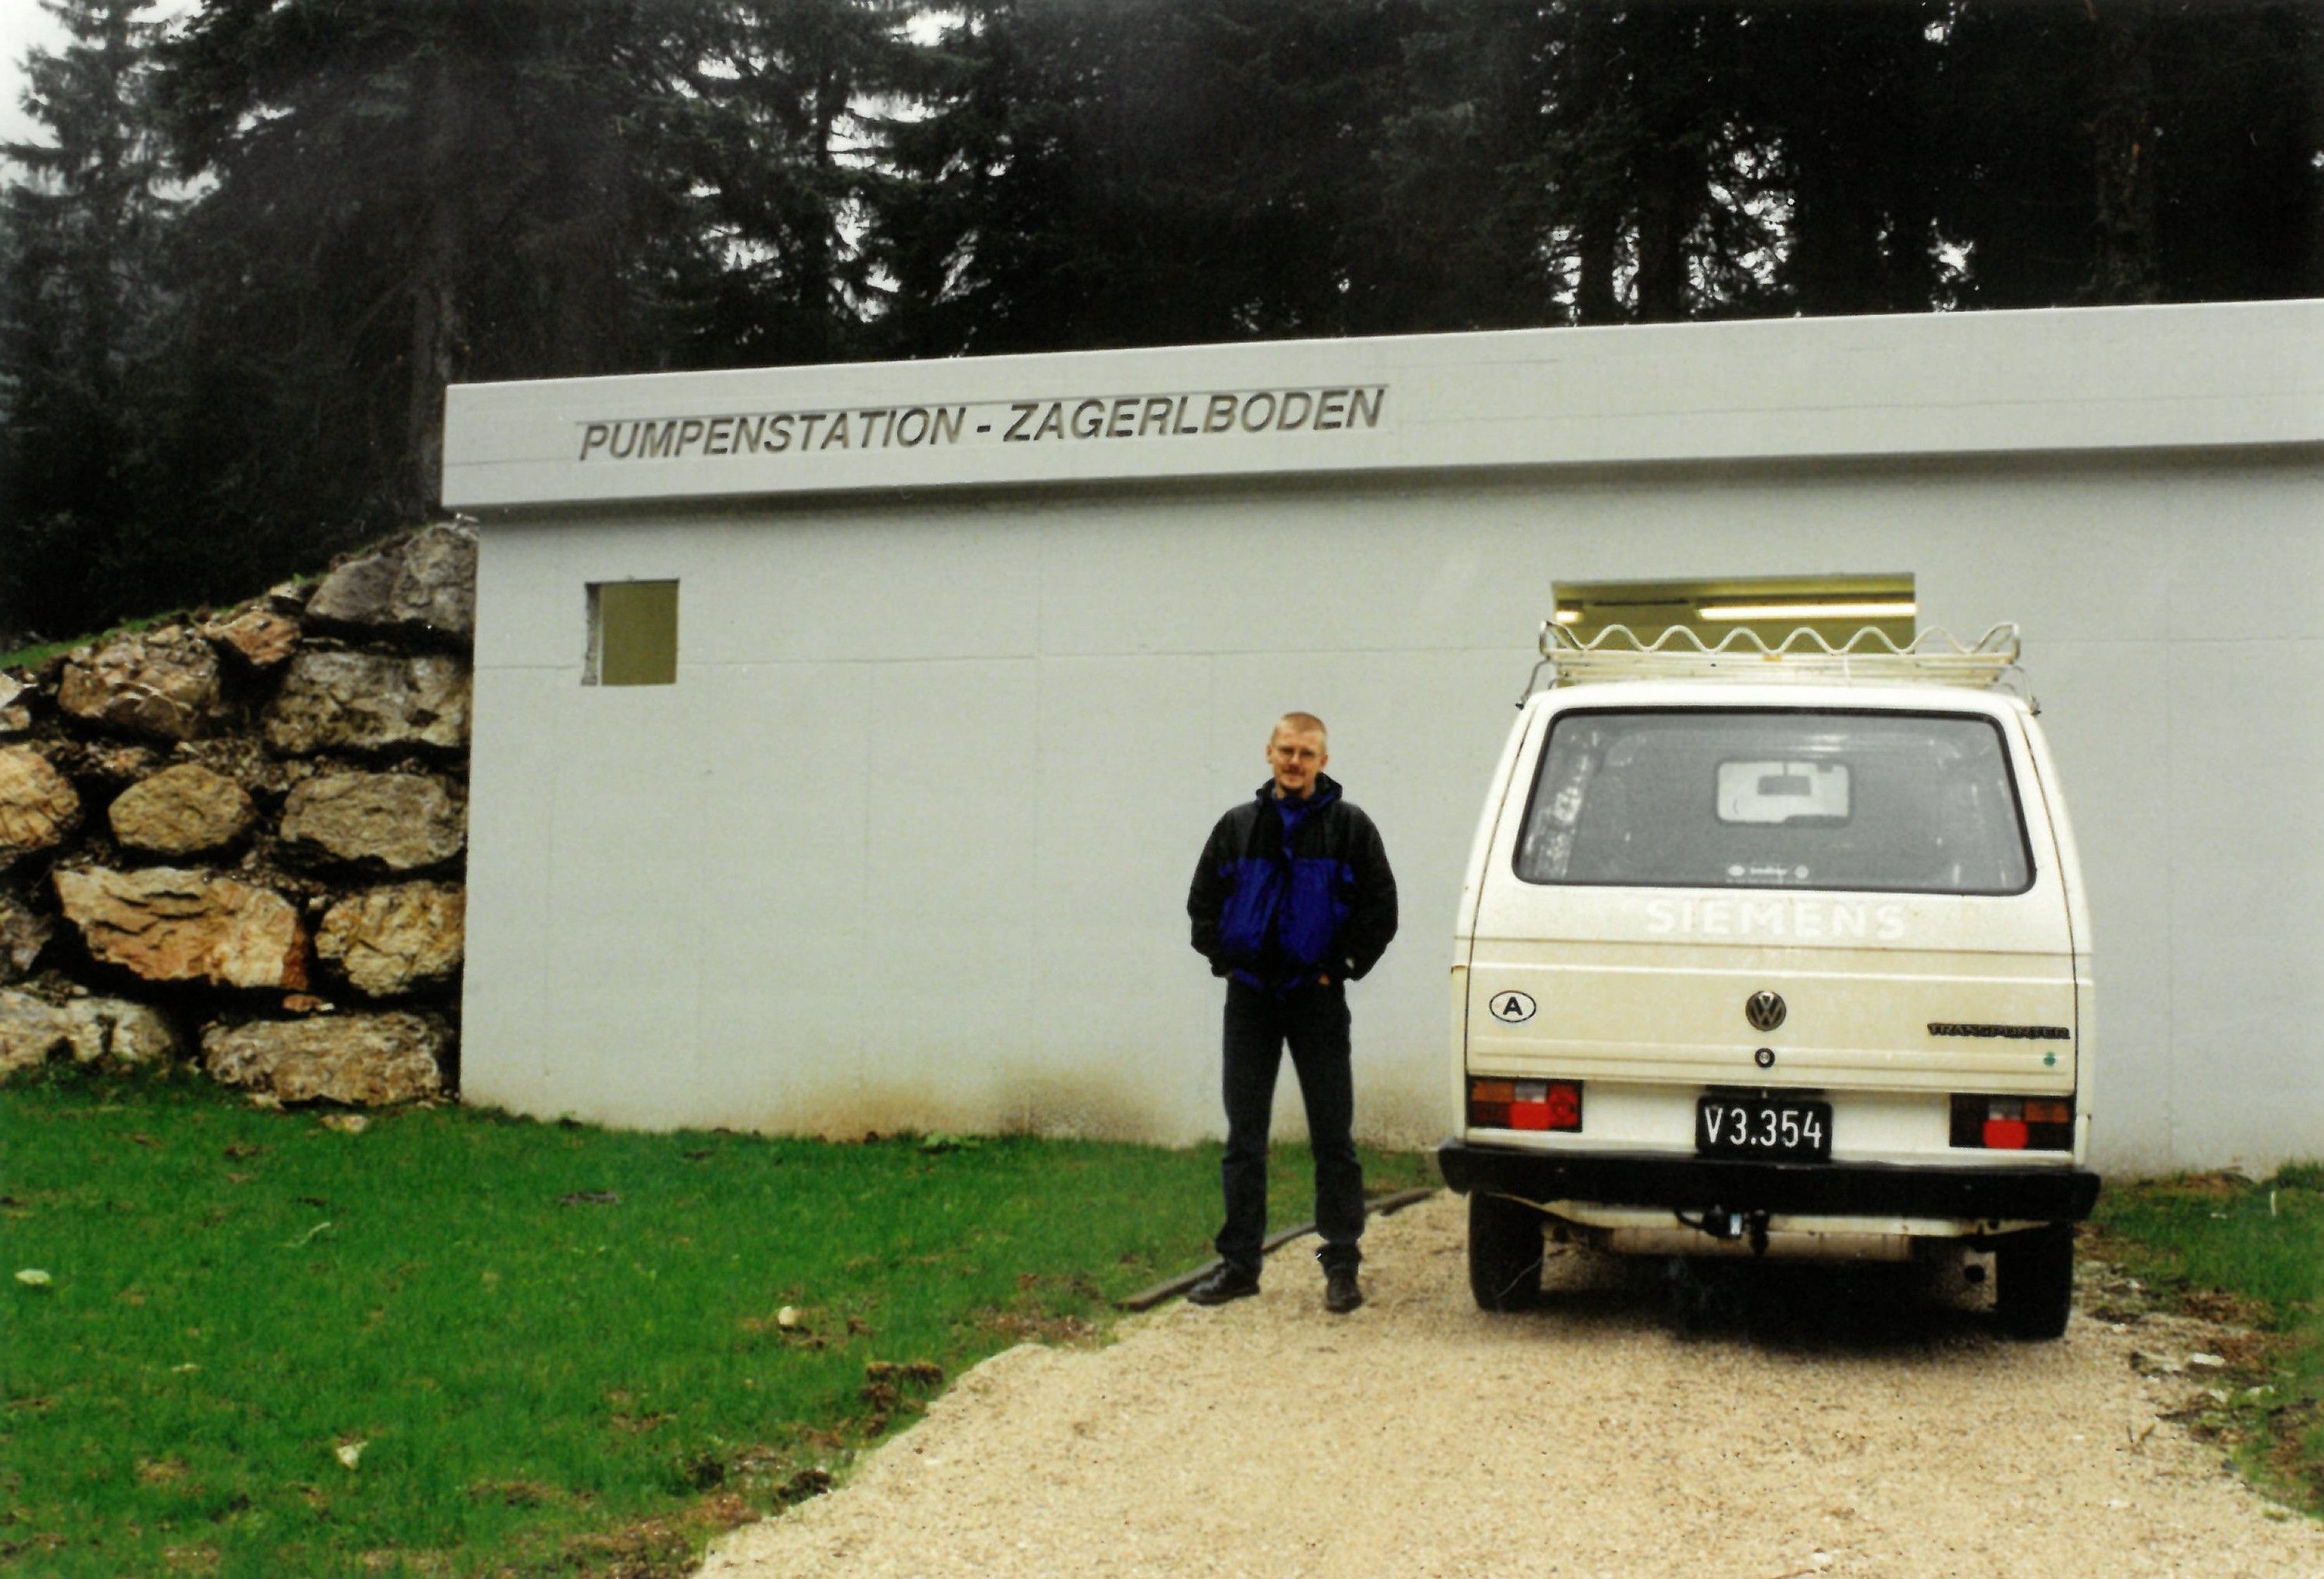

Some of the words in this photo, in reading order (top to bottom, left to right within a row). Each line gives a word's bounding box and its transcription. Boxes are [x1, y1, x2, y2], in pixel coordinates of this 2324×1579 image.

[580, 406, 966, 461] PUMPENSTATION
[1004, 389, 1384, 442] ZAGERLBODEN
[1645, 898, 1907, 940] SIEMENS
[1502, 996, 1523, 1016] A
